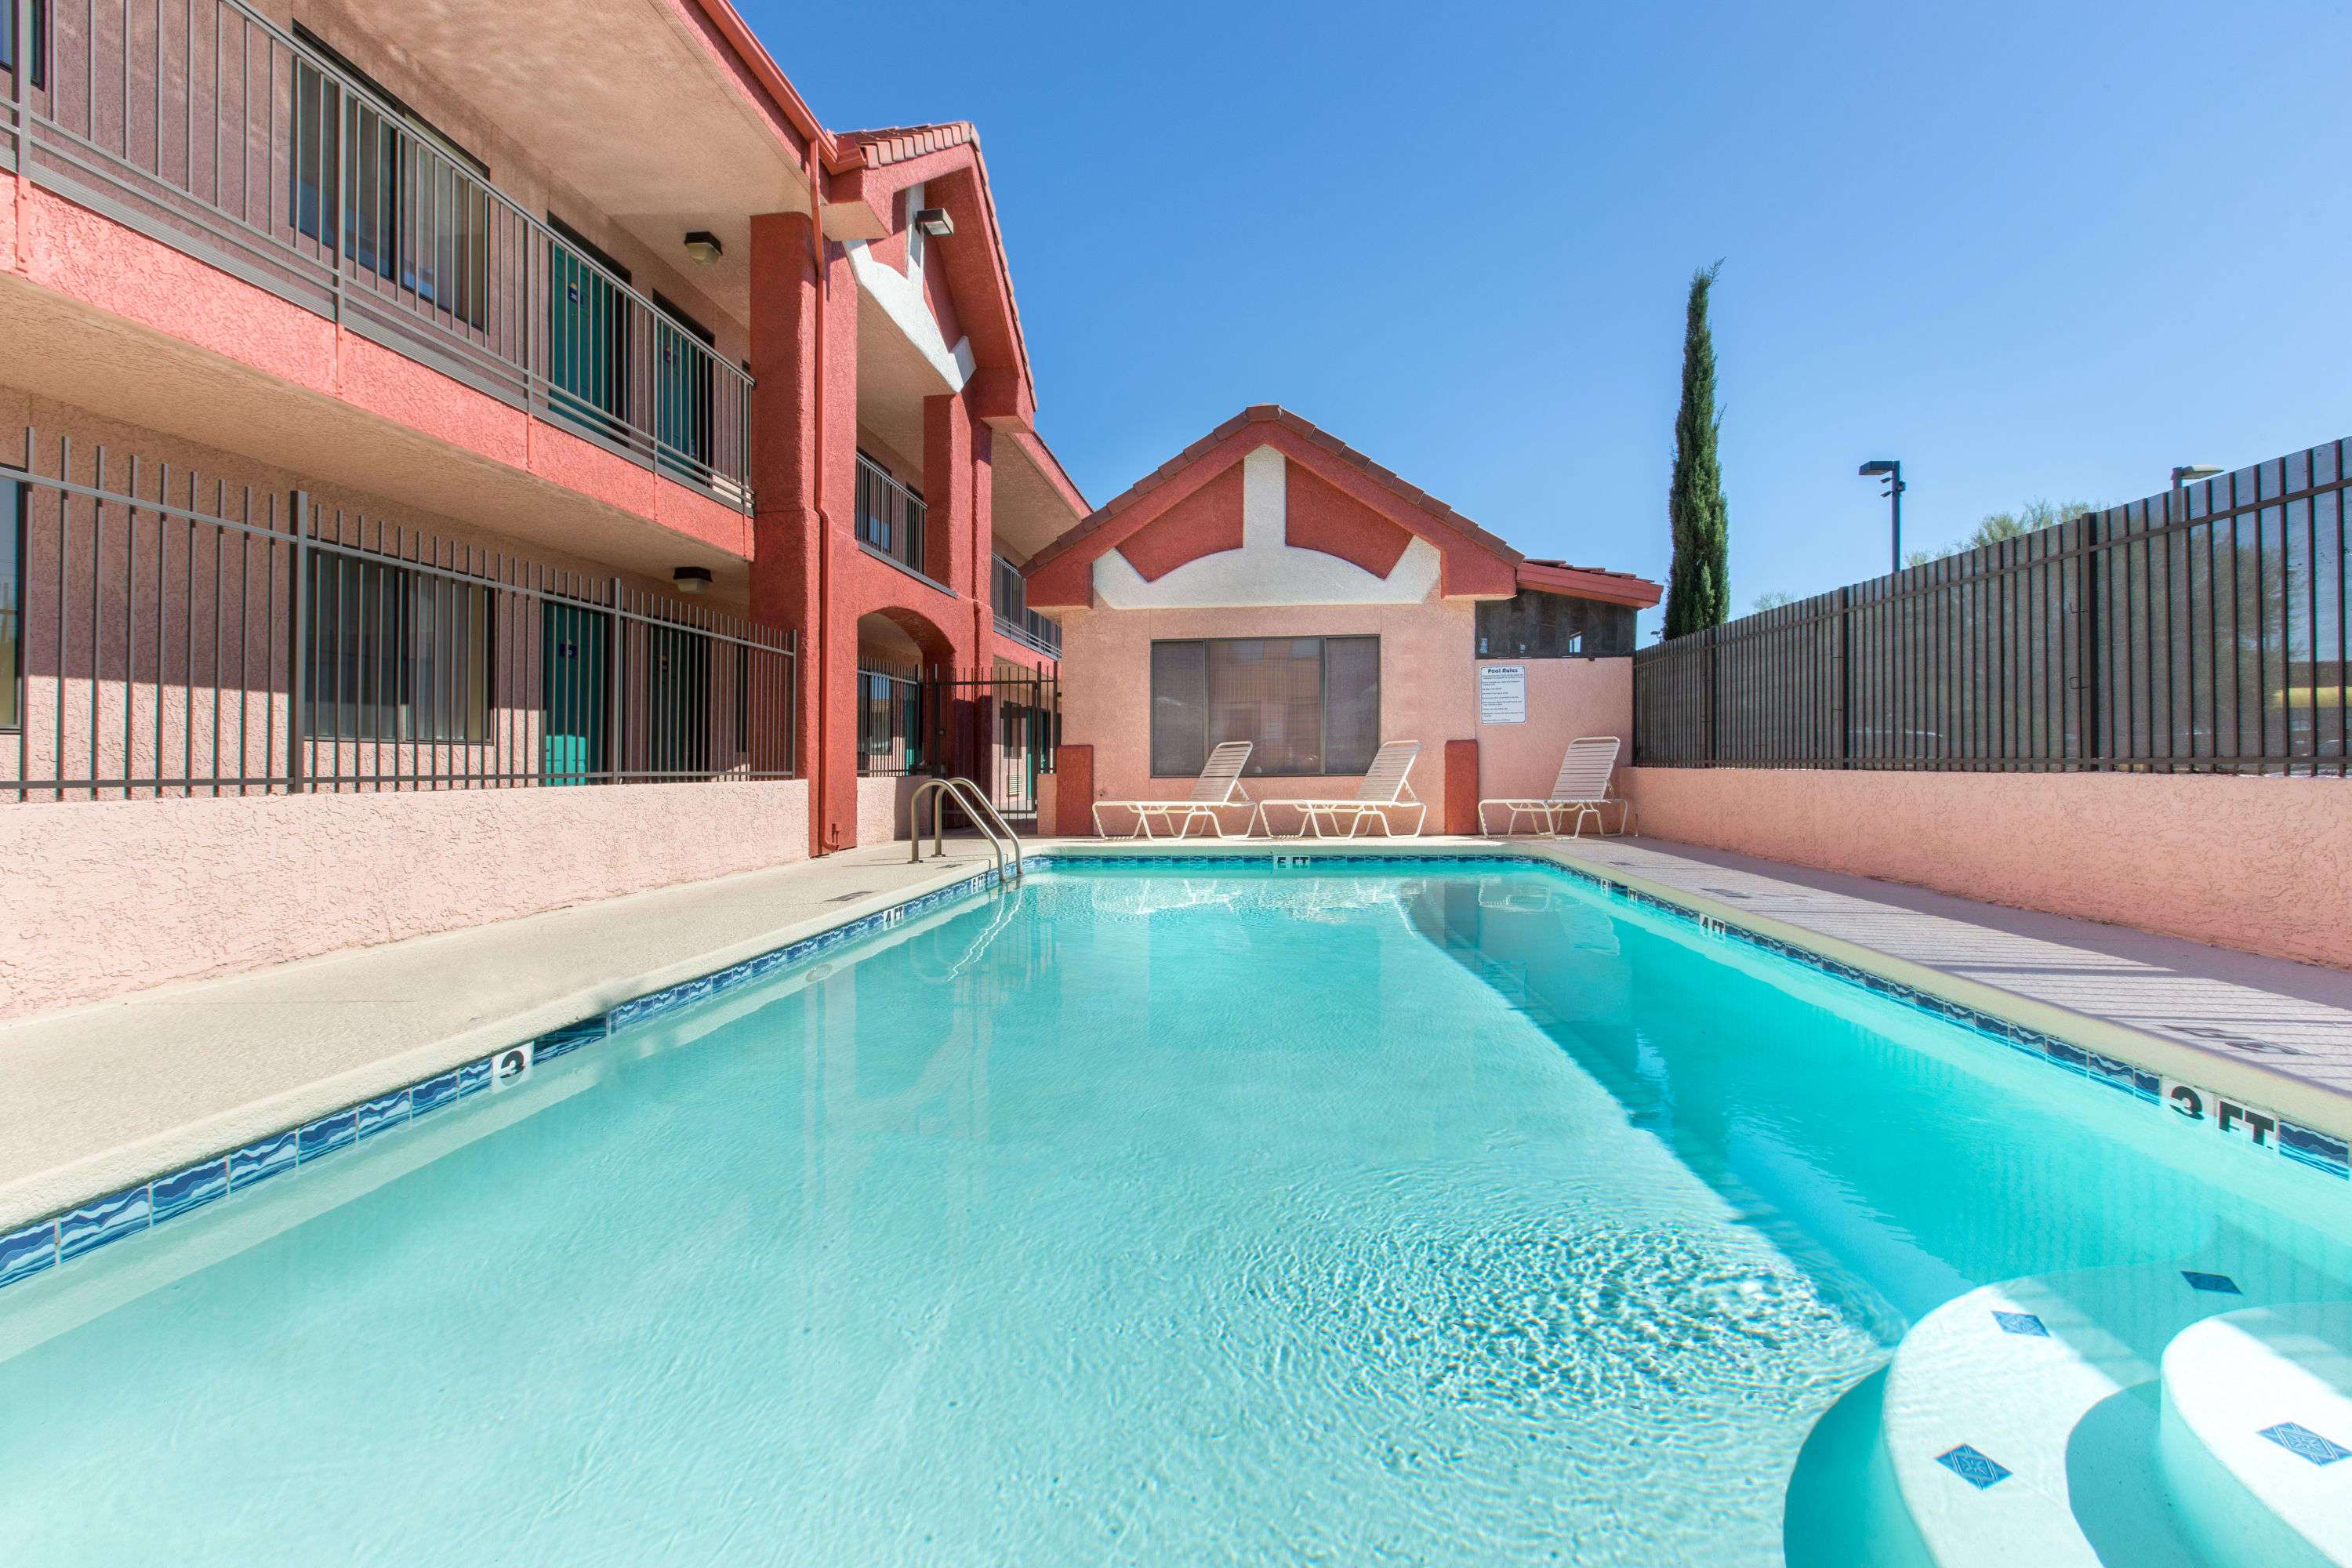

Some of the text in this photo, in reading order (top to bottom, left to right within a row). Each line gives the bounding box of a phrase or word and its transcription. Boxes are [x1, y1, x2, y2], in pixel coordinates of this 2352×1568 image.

[1292, 856, 1309, 866] FT
[885, 906, 903, 924] 4 FT
[1701, 916, 1724, 935] 4 FT
[500, 1050, 525, 1080] 3
[2169, 1086, 2275, 1148] 3 FT
